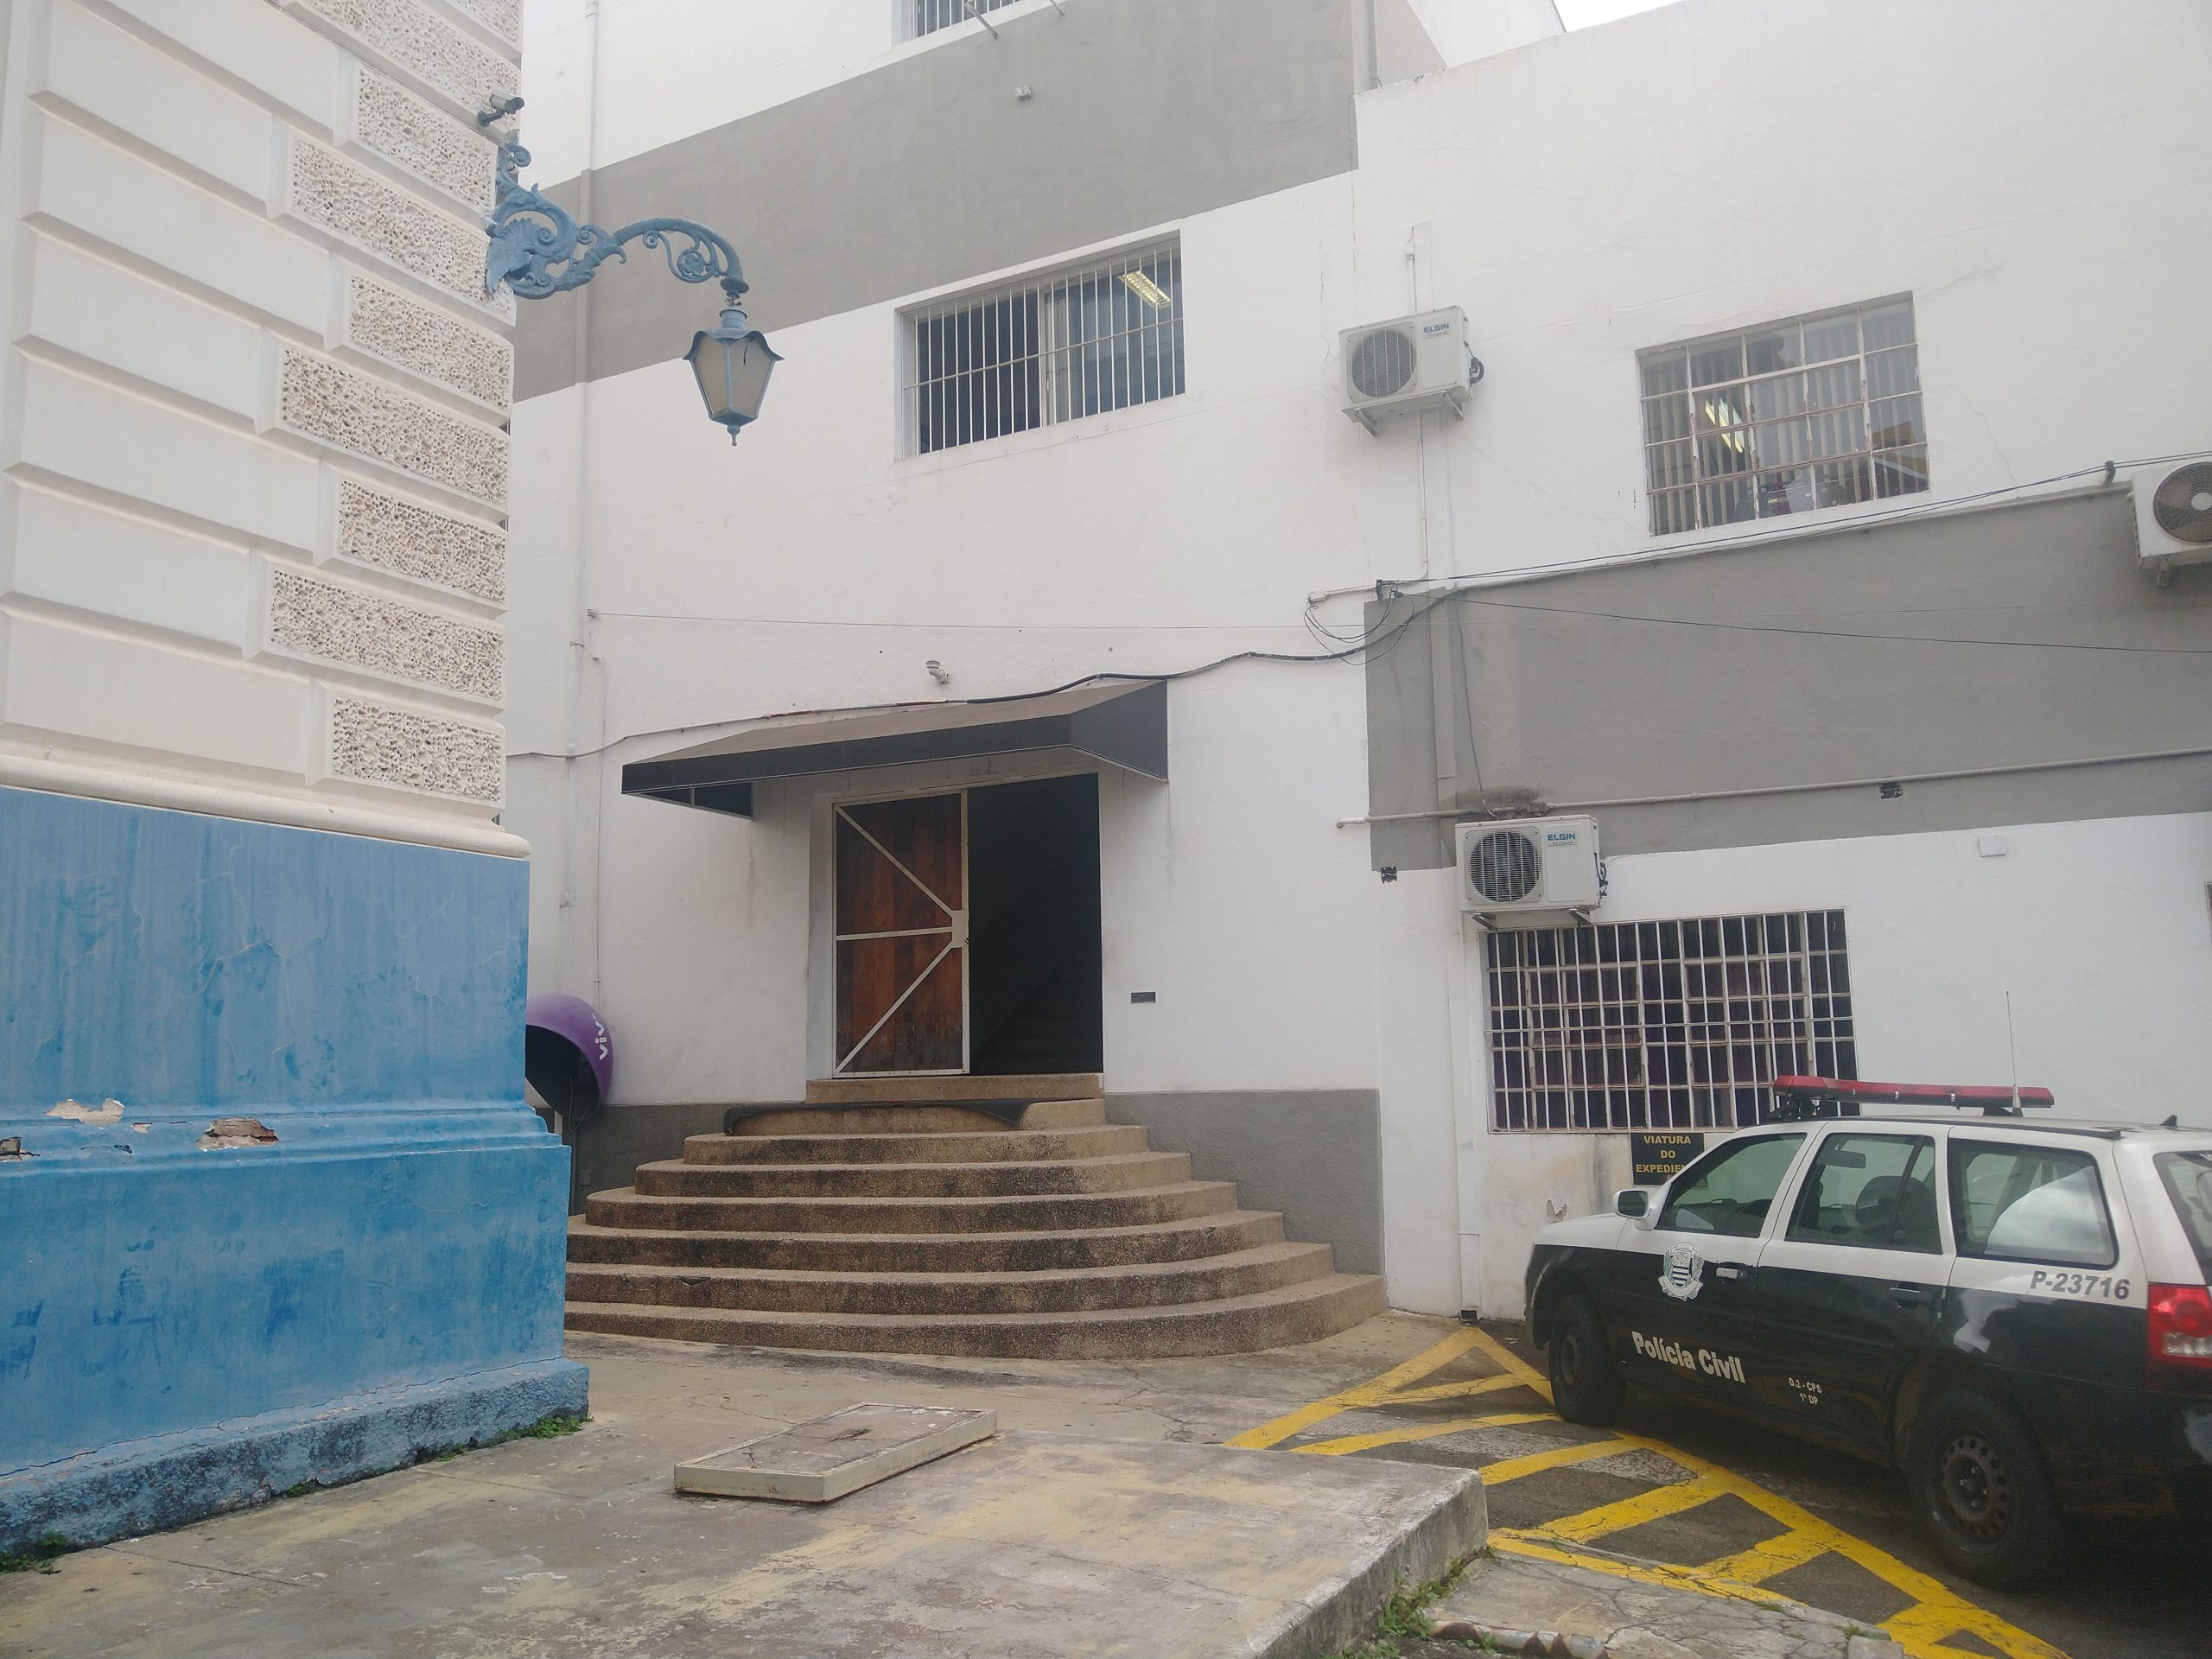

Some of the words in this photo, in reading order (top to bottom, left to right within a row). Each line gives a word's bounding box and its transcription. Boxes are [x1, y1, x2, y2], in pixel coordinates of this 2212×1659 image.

[1423, 323, 1449, 334] ELGIN
[592, 1012, 608, 1061] viv
[1643, 1135, 1691, 1145] VIATURA
[1660, 1150, 1676, 1159] DO
[2031, 1270, 2130, 1300] P-23716
[1632, 1331, 1697, 1370] Polícia
[1698, 1349, 1745, 1383] Civil
[1806, 1382, 1822, 1394] CPS
[1808, 1395, 1818, 1405] DP
